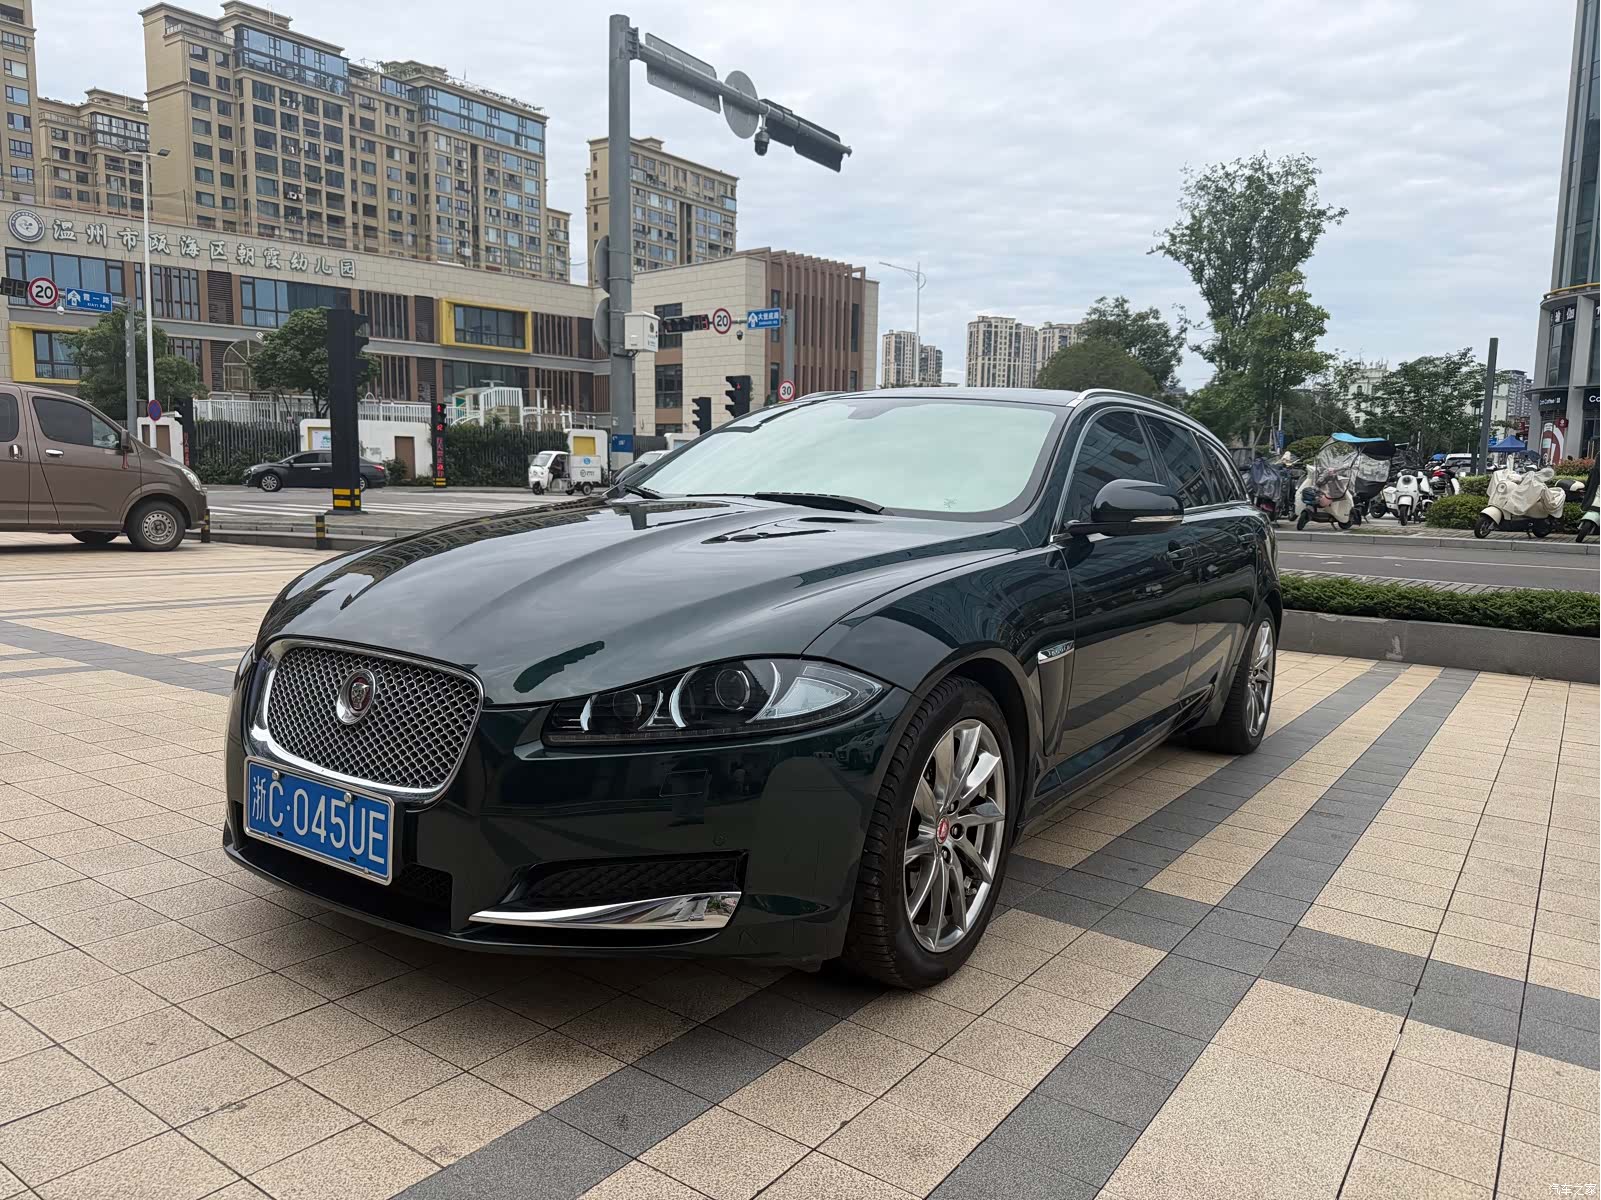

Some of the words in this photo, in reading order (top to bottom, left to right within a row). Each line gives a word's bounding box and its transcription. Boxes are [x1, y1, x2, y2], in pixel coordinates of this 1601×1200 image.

[53, 219, 356, 279] 温州市瓯海区朝霞幼儿园
[35, 285, 53, 299] 20
[716, 315, 728, 327] 20
[781, 386, 792, 396] 30
[252, 776, 385, 865] 浙C·045UE
